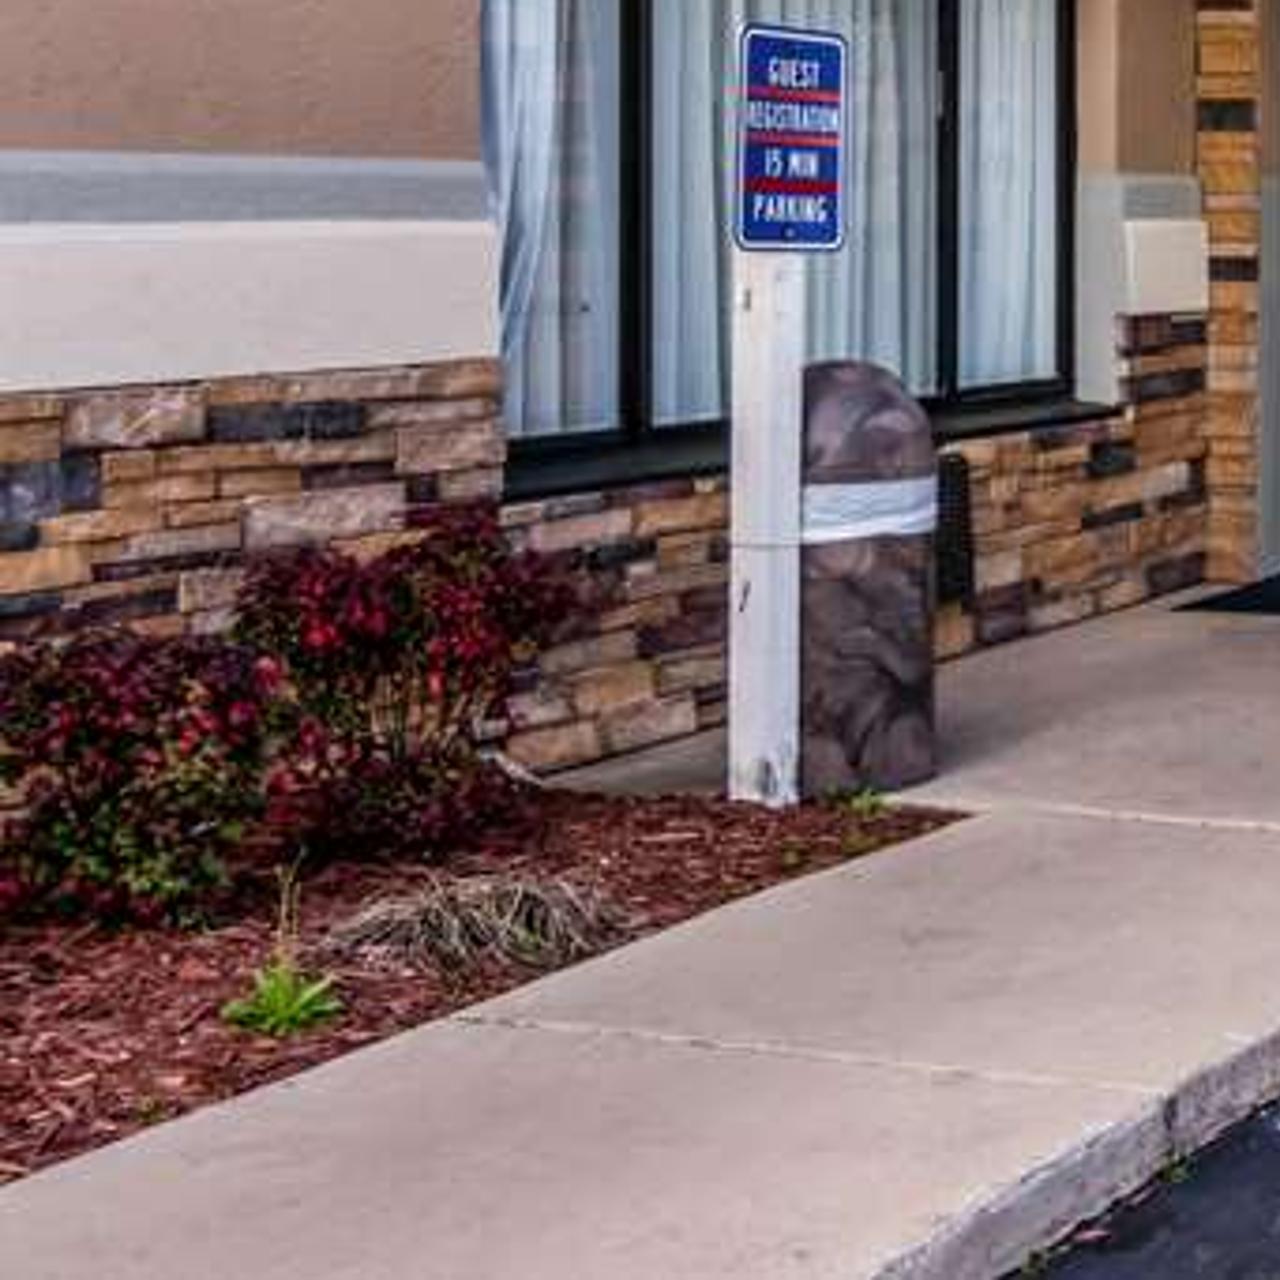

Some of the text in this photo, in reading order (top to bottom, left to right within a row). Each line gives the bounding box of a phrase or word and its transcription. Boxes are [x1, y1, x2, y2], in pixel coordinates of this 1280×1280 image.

[768, 56, 820, 88] GUEST
[746, 102, 838, 131] REGISTRATION
[765, 147, 819, 179] 15 MIN
[753, 193, 829, 223] PARKING
